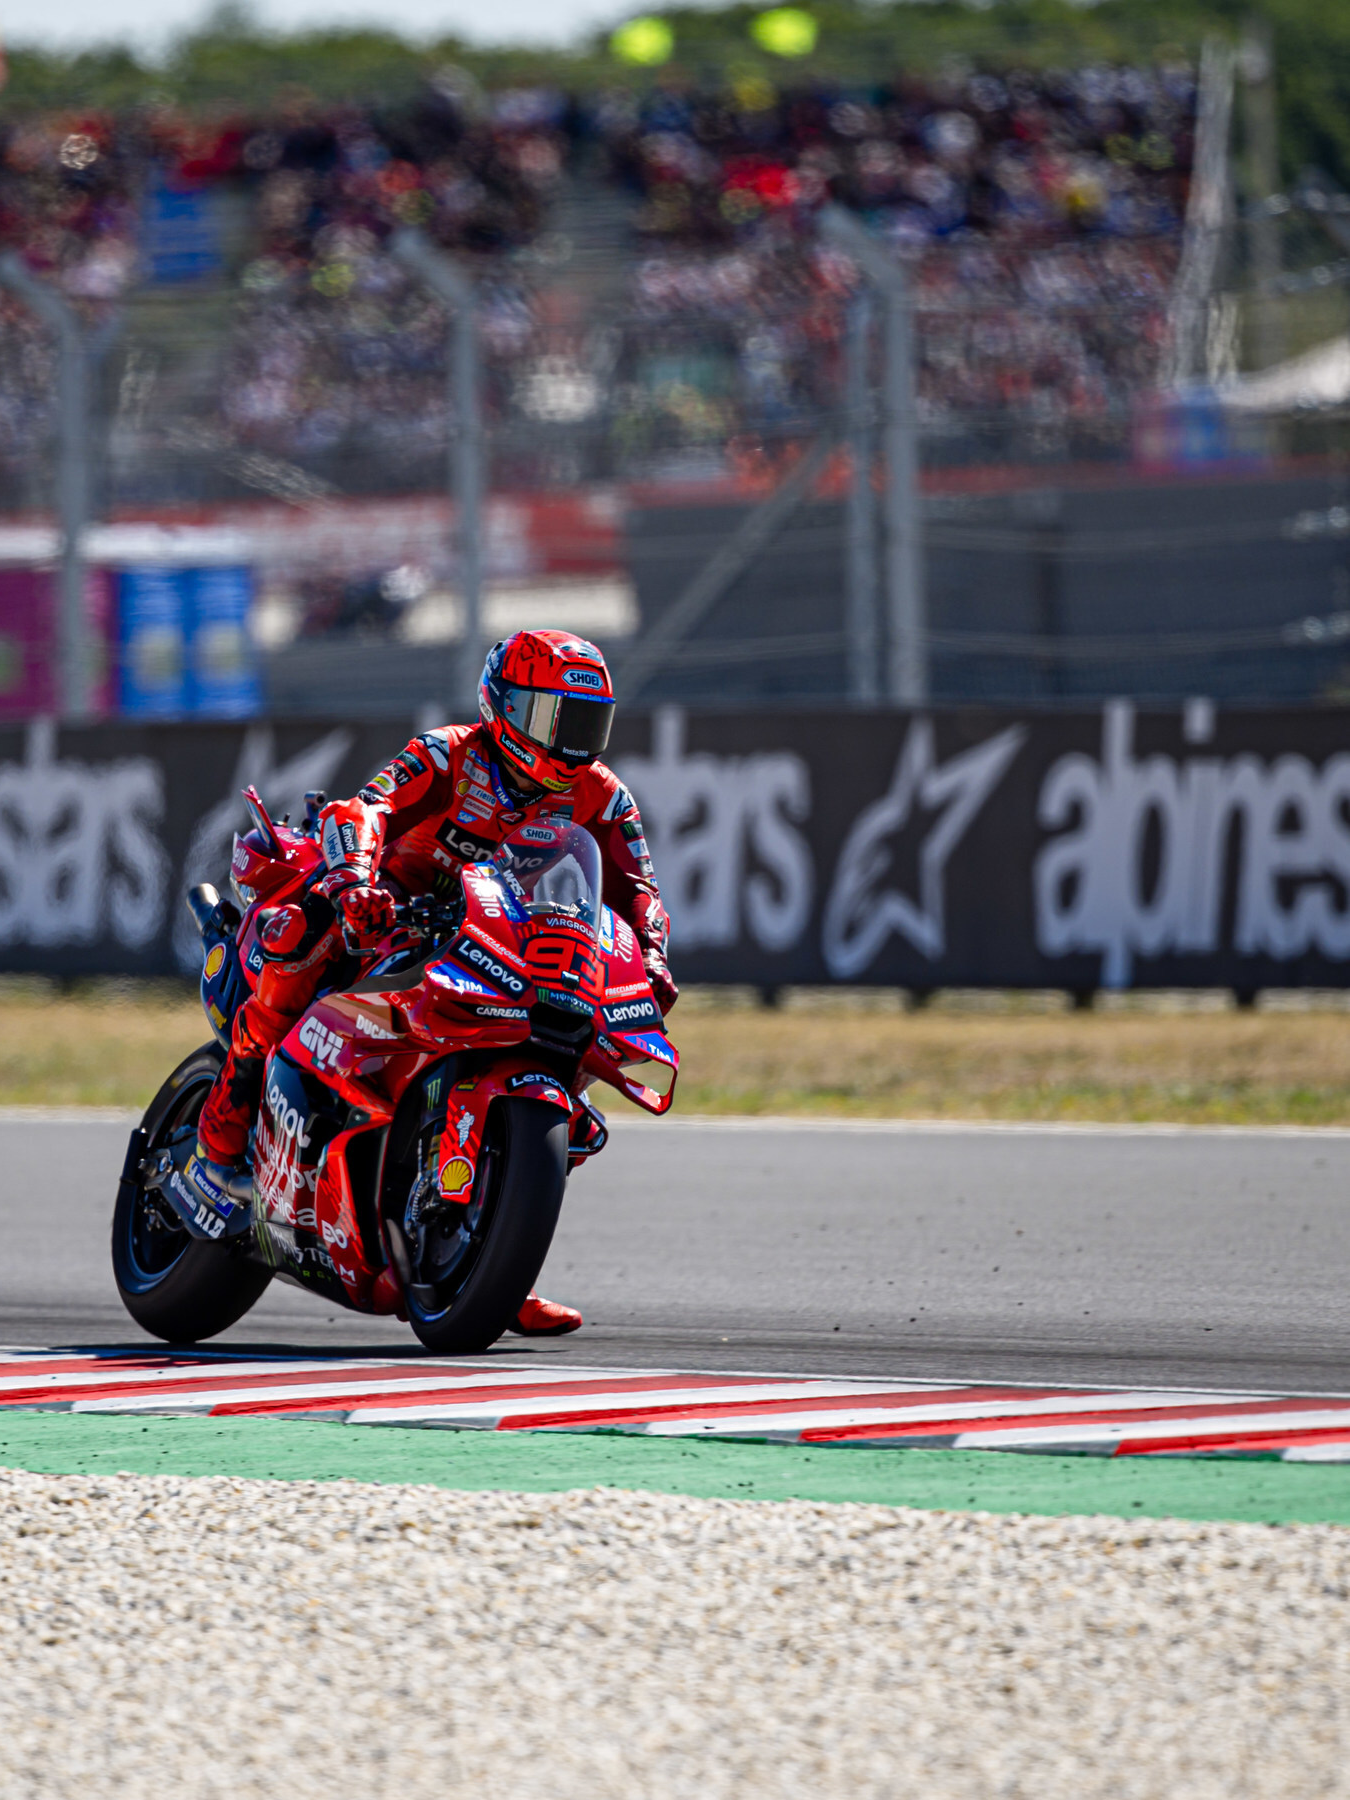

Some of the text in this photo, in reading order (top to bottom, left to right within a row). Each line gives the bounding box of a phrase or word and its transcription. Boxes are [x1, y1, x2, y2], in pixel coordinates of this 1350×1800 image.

[569, 672, 599, 687] SHOEI
[501, 734, 532, 763] Lenovo
[562, 747, 589, 757] Insta360
[476, 788, 497, 804] riello
[495, 786, 509, 805] TIM
[342, 824, 355, 851] Lenovo
[526, 828, 552, 840] SHOEI
[233, 847, 250, 871] ello
[503, 869, 526, 897] WRS
[466, 924, 527, 968] FRECCIAROSSA
[613, 919, 634, 953] riello
[458, 940, 523, 992] Lenovo
[521, 934, 606, 1000] 93
[605, 982, 650, 996] FRECCIAROSSA
[476, 1006, 528, 1018] CARRERA
[603, 1002, 654, 1023] Lenovo
[299, 1015, 344, 1067] GIVI
[648, 1043, 672, 1062] TIM
[512, 1073, 567, 1096] Lenov
[265, 1065, 312, 1148] Lenov
[193, 1172, 230, 1207] MICHELIN
